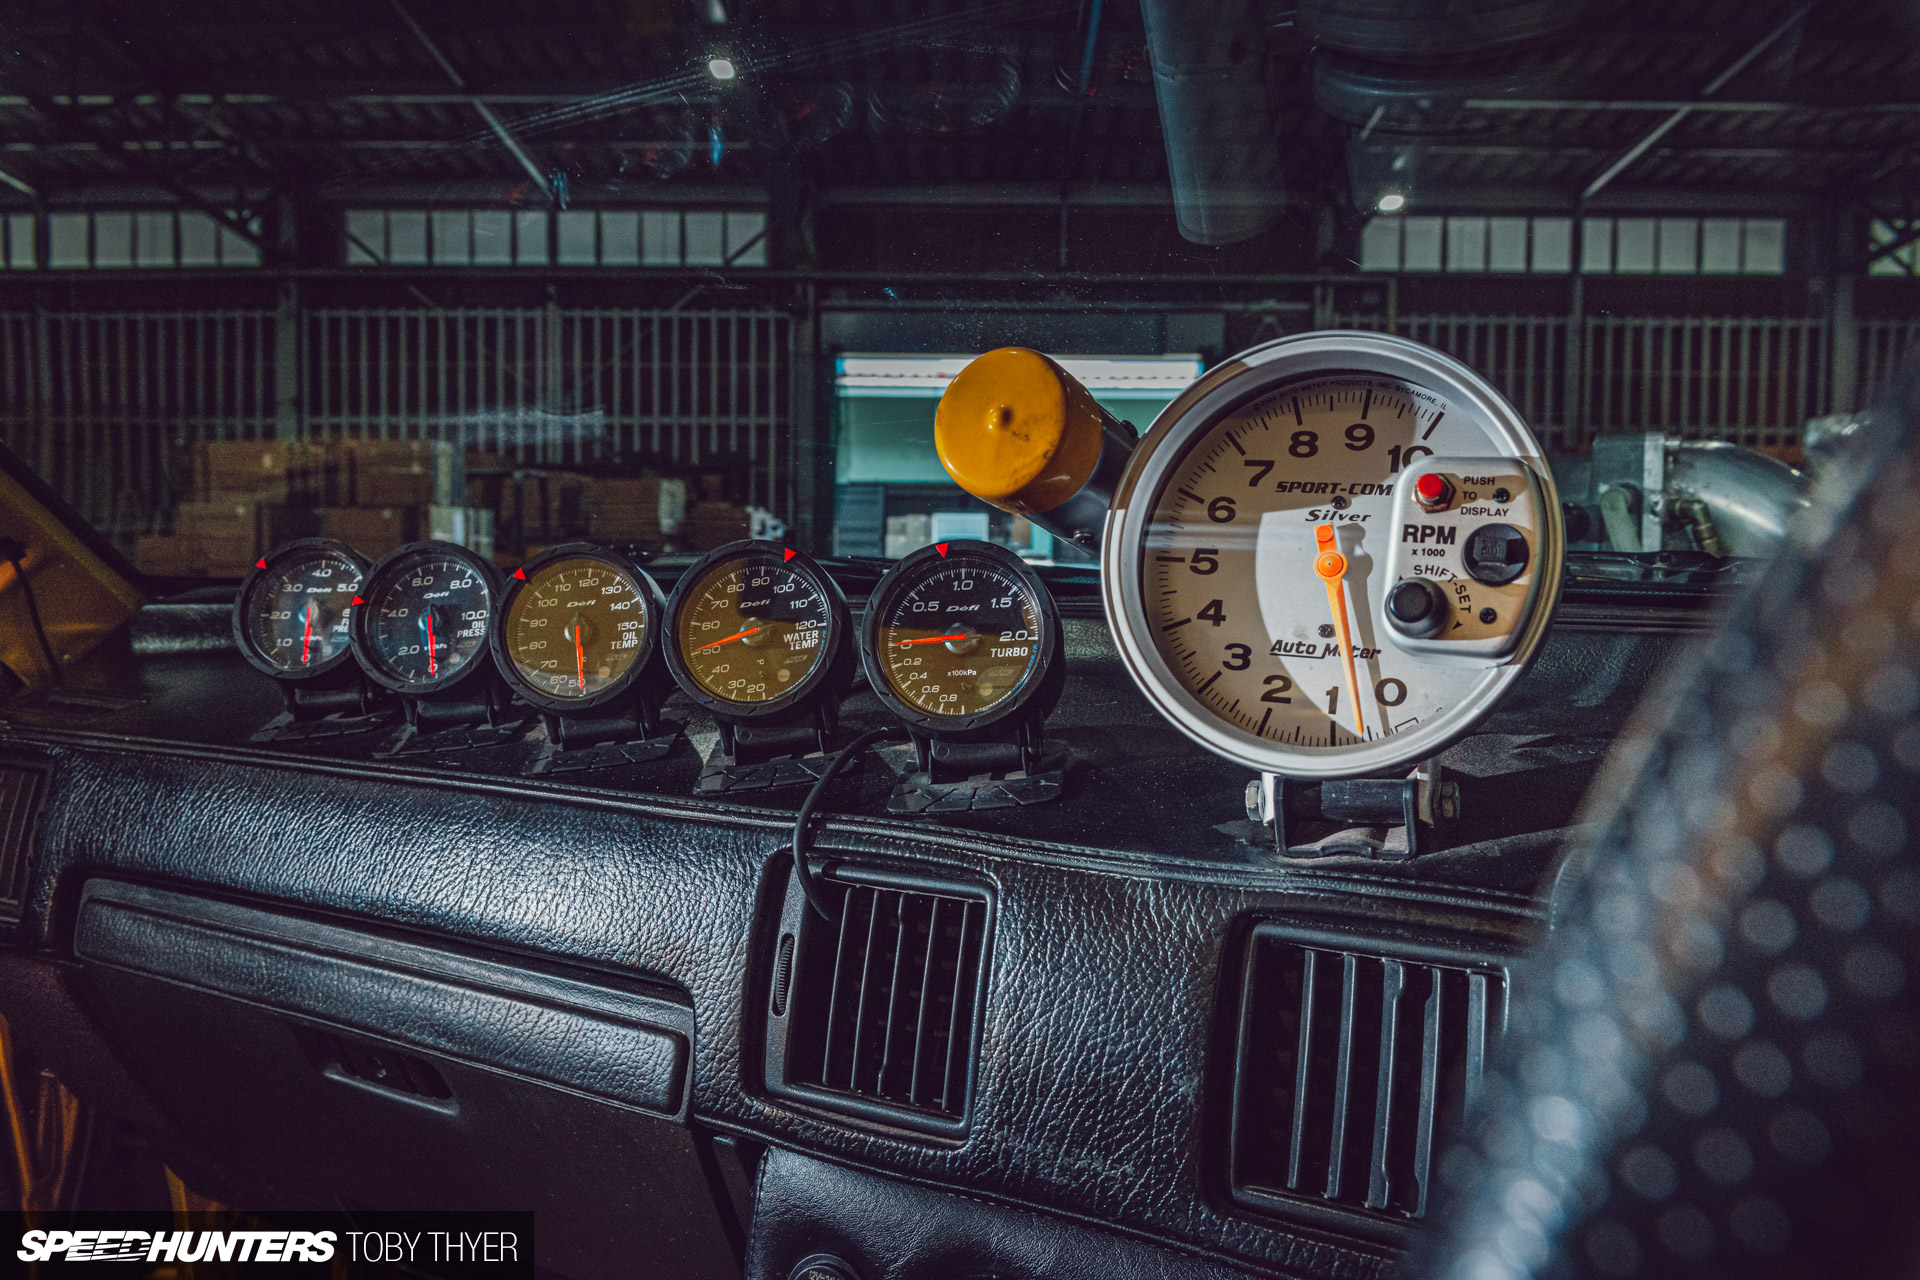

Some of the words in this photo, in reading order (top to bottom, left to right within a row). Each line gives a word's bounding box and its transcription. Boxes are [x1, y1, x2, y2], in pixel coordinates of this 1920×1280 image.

[1279, 387, 1299, 398] AUTO
[1301, 382, 1327, 390] METER
[1330, 380, 1374, 388] PRODUCTS,
[1396, 385, 1438, 406] SYCAMORE,
[1440, 402, 1447, 410] IL
[1344, 423, 1375, 451] 9
[1288, 430, 1319, 458] 8
[1243, 459, 1276, 487] 7
[1463, 476, 1496, 486] PUSH
[1275, 481, 1394, 496] SPORT-COM
[1462, 491, 1478, 500] TO
[1207, 496, 1236, 524] 6
[1460, 506, 1510, 517] DISPLAY
[1304, 509, 1372, 522] Silver
[1402, 524, 1457, 545] RPM
[1411, 548, 1418, 556] x
[1422, 548, 1446, 557] 1000
[1189, 547, 1220, 576] 5
[312, 568, 332, 578] 4.0
[412, 576, 434, 586] 6.0
[450, 578, 472, 590] 8.0
[578, 578, 599, 587] 120
[751, 576, 770, 586] 90
[952, 580, 974, 591] 1.0
[282, 584, 303, 592] 3.0
[336, 583, 358, 592] 5.0
[554, 584, 571, 592] 110
[601, 586, 622, 595] 130
[726, 583, 746, 593] 80
[772, 583, 795, 594] 100
[1414, 564, 1472, 614] SHIFT-SET
[538, 598, 558, 608] 100
[610, 602, 630, 611] 140
[711, 599, 729, 610] 70
[790, 598, 808, 610] 110
[912, 600, 940, 612] 0.5
[990, 597, 1013, 609] 1.5
[270, 611, 292, 620] 2.0
[388, 608, 408, 618] 4.0
[461, 610, 486, 620] 10.0
[1196, 599, 1227, 628] 4
[472, 620, 486, 629] OIL
[530, 618, 548, 628] 90
[616, 621, 638, 630] 150
[702, 620, 720, 630] 60
[794, 620, 816, 630] 120
[332, 625, 350, 633] PRE
[457, 628, 486, 638] PRESS
[622, 632, 638, 640] OIL
[783, 630, 819, 642] WATER
[1000, 630, 1028, 642] 2.0
[276, 638, 293, 646] 1.0
[529, 641, 547, 650] 80
[610, 640, 638, 650] TEMP
[789, 638, 818, 650] TEMP
[398, 645, 420, 656] 2.0
[702, 645, 720, 655] 50
[990, 646, 1029, 658] TURBO
[1270, 639, 1317, 656] Auto
[1322, 643, 1382, 660] Mter
[903, 657, 922, 666] 0.2
[1222, 642, 1253, 671] 3
[540, 660, 558, 669] 70
[712, 664, 730, 674] 40
[910, 672, 928, 680] 0.4
[947, 669, 977, 677] x100kPa
[550, 675, 568, 684] 60
[728, 679, 746, 690] 30
[746, 683, 766, 694] 20
[922, 684, 940, 694] 0.6
[1260, 674, 1292, 704] 2
[1374, 677, 1408, 707] 0
[938, 694, 958, 702] 0.8
[1326, 686, 1339, 715] 1
